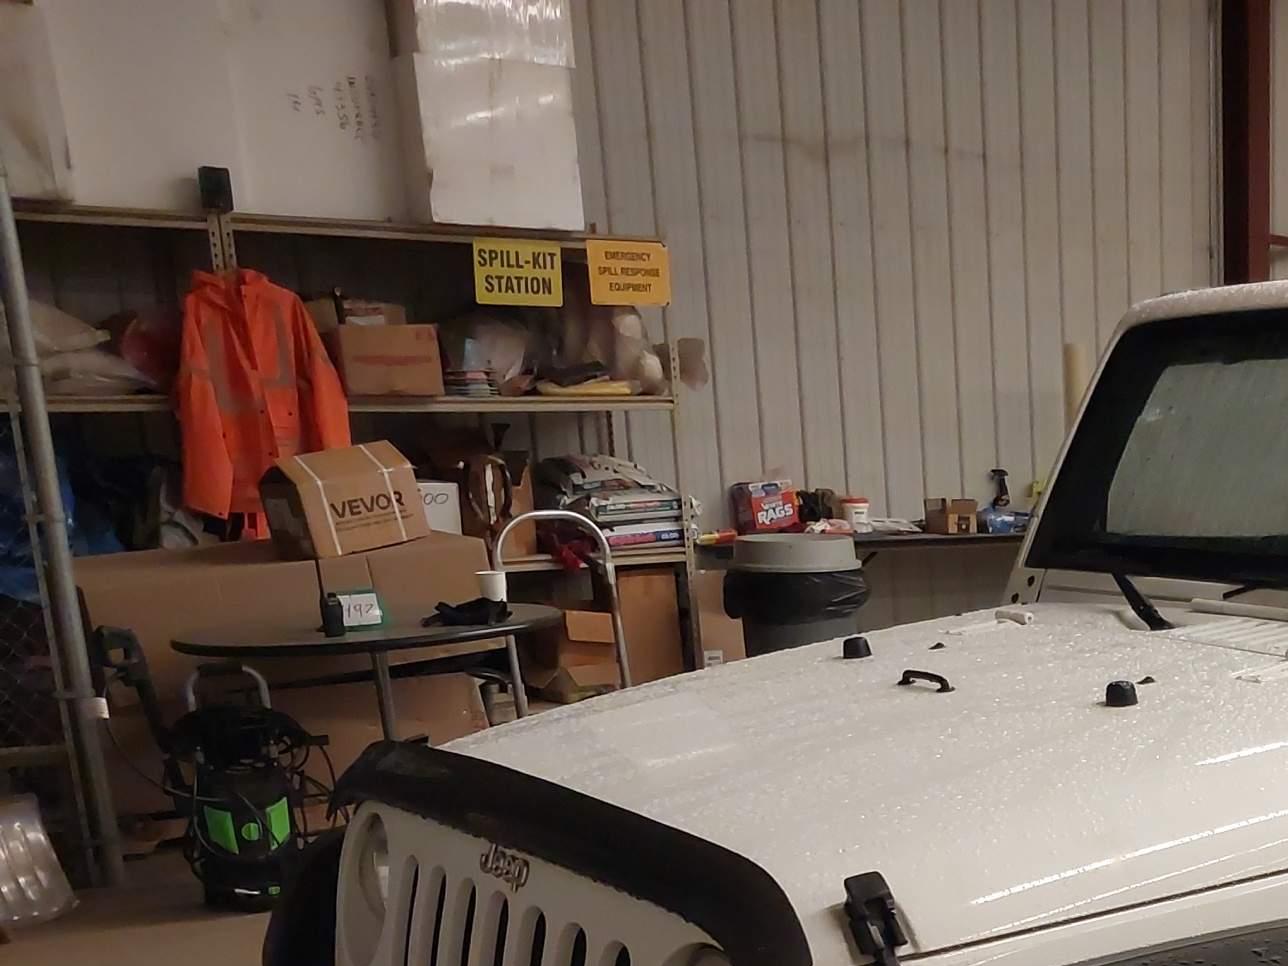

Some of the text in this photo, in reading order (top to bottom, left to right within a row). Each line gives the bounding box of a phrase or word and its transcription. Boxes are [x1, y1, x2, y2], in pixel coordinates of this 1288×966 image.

[477, 249, 557, 270] SPILL-KIT
[604, 250, 651, 262] EMERGENCY
[598, 266, 661, 278] SPILL RESPONSE
[485, 274, 552, 295] STATION
[608, 282, 652, 293] EQUIPMENT
[329, 490, 405, 519] VEVOR
[757, 503, 794, 525] RAGS
[480, 843, 529, 893] Jeep
